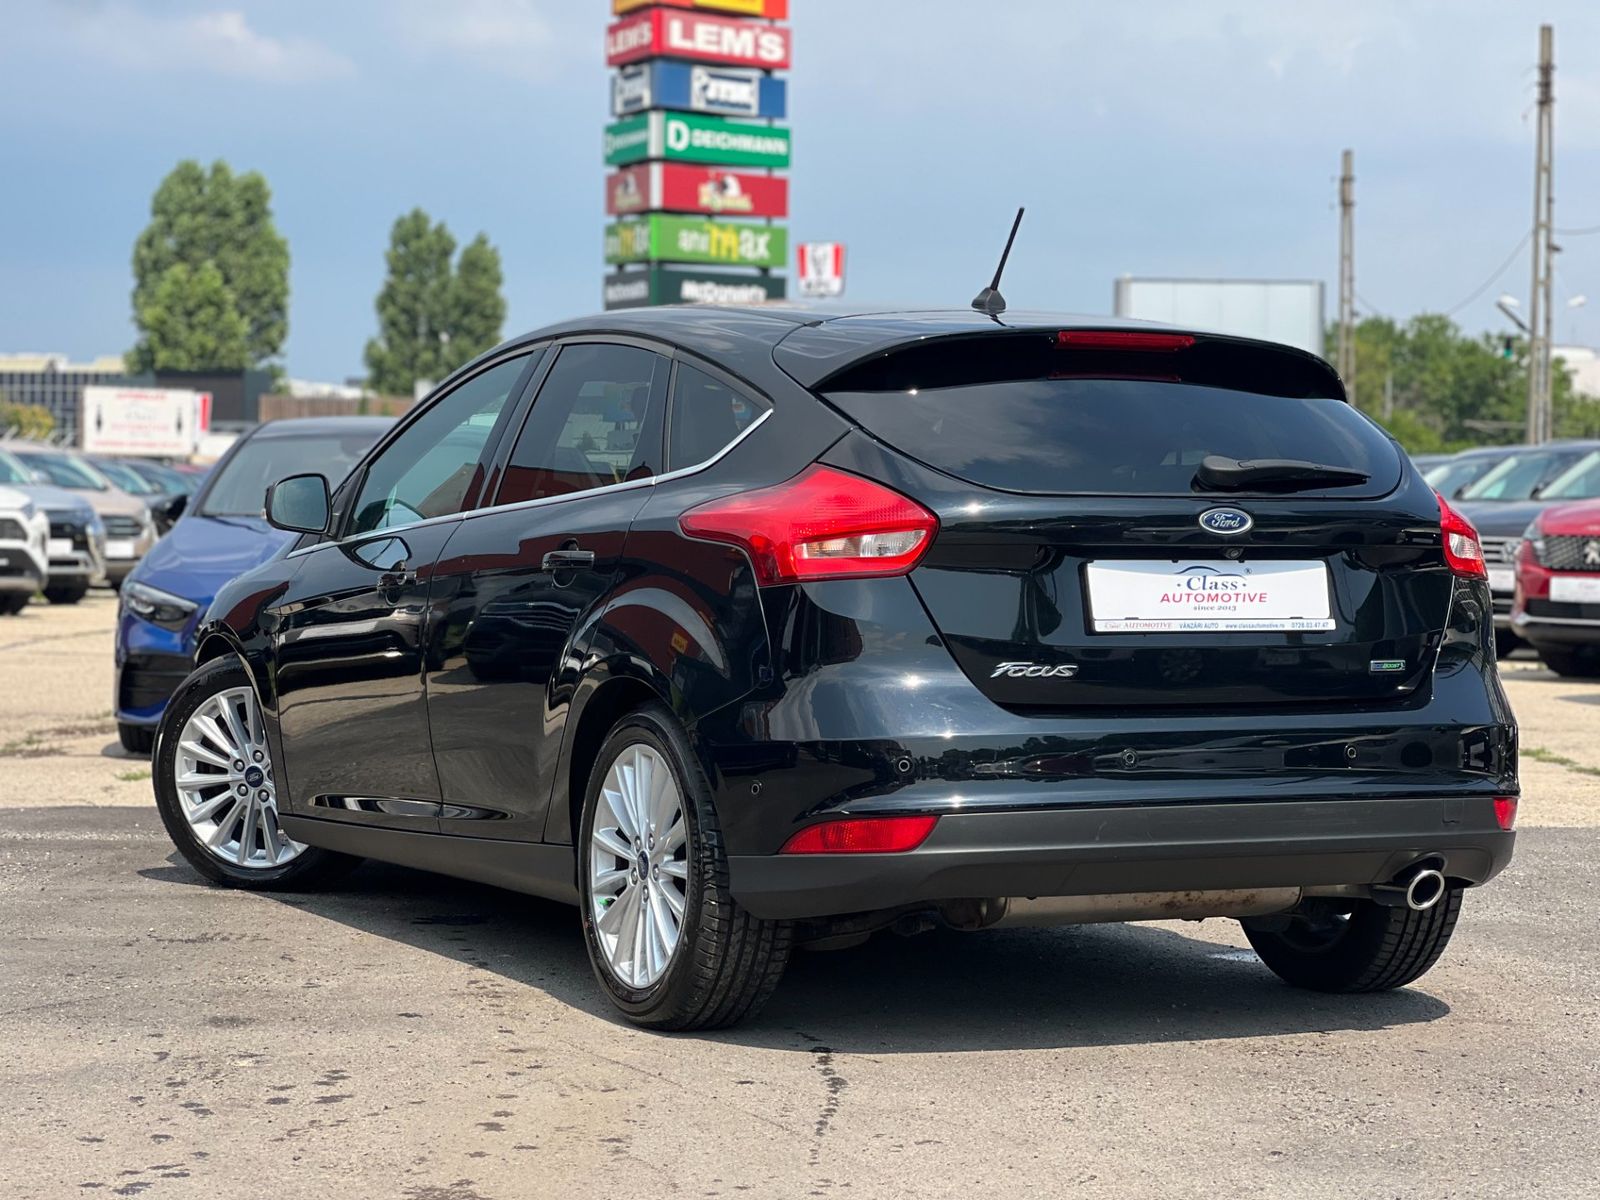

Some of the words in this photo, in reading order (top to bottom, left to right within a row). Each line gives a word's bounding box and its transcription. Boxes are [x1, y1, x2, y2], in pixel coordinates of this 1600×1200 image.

[669, 20, 784, 61] LEM'S
[1211, 512, 1241, 528] Ford
[1186, 575, 1239, 591] Class
[1160, 592, 1268, 603] AUTOMOTIVE
